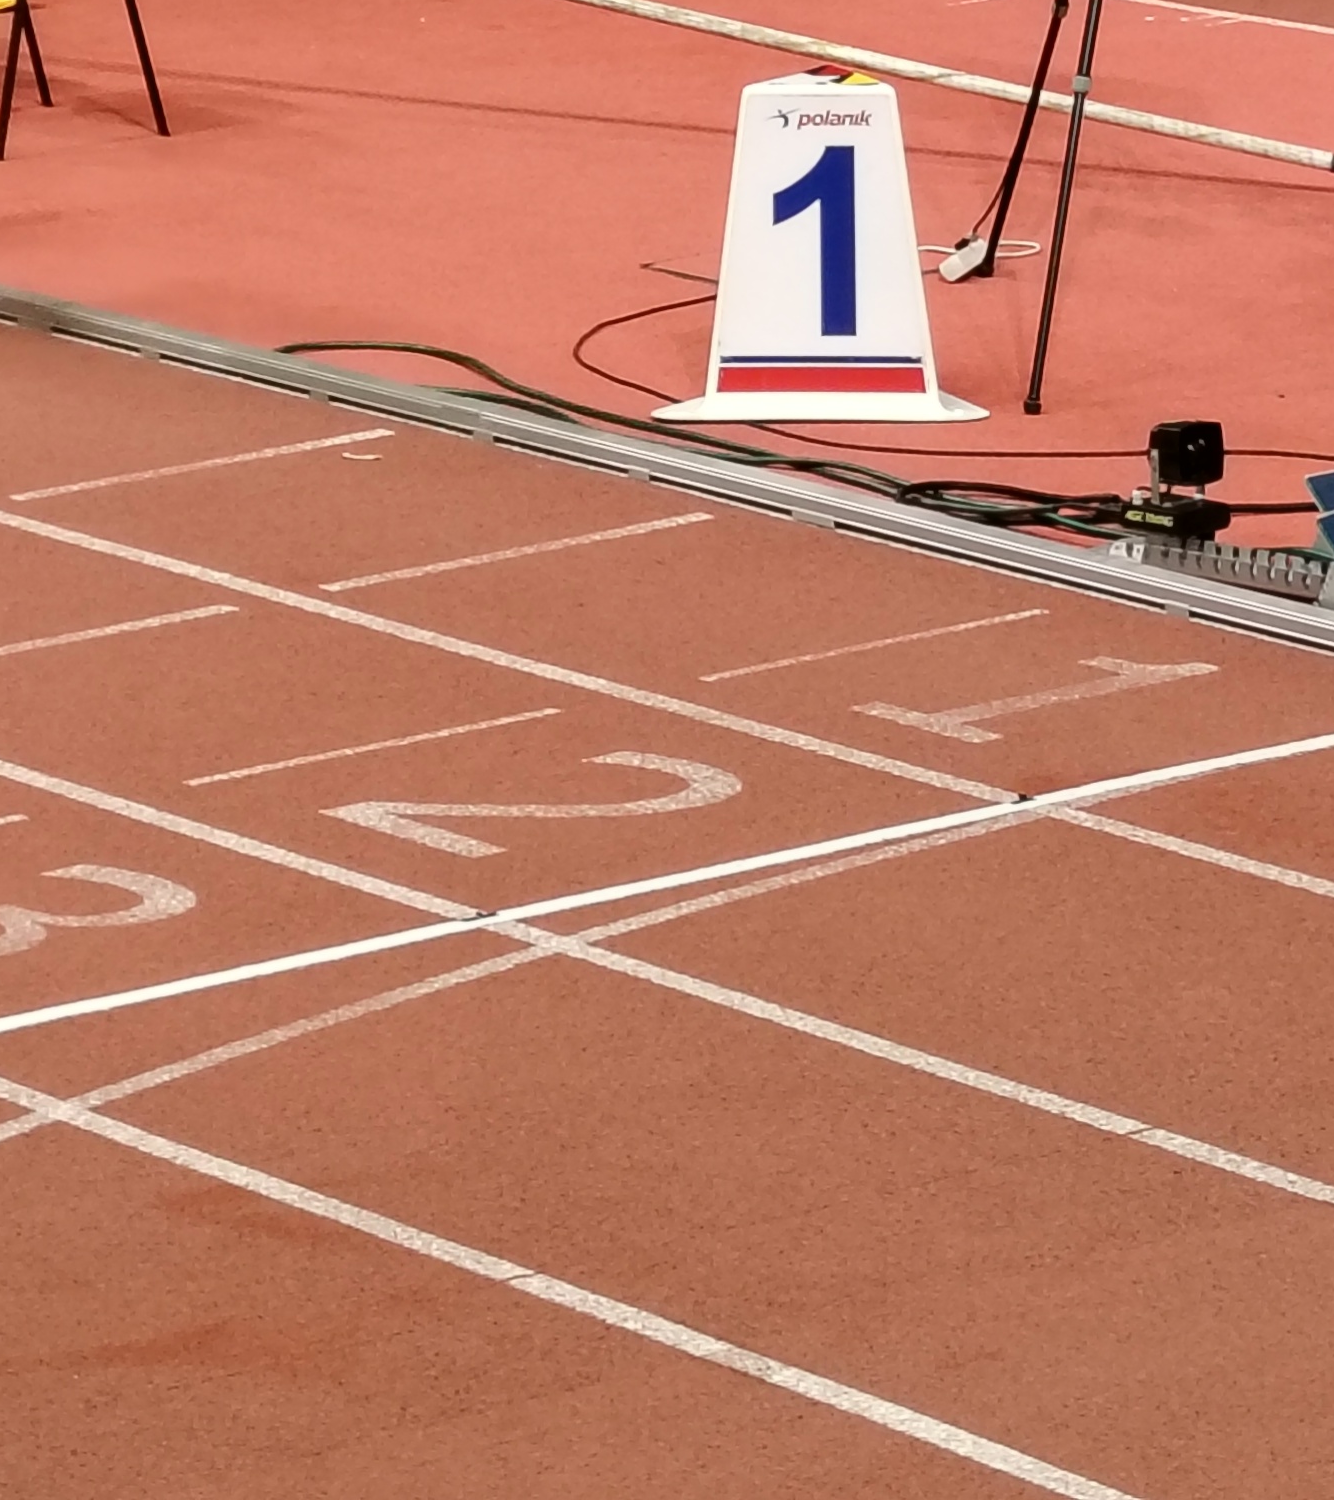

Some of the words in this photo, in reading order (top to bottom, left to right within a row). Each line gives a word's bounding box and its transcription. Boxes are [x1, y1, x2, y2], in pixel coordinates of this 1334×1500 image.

[797, 109, 873, 131] polanik
[772, 146, 857, 338] 1
[852, 655, 1220, 742] 1
[318, 750, 744, 858] 2
